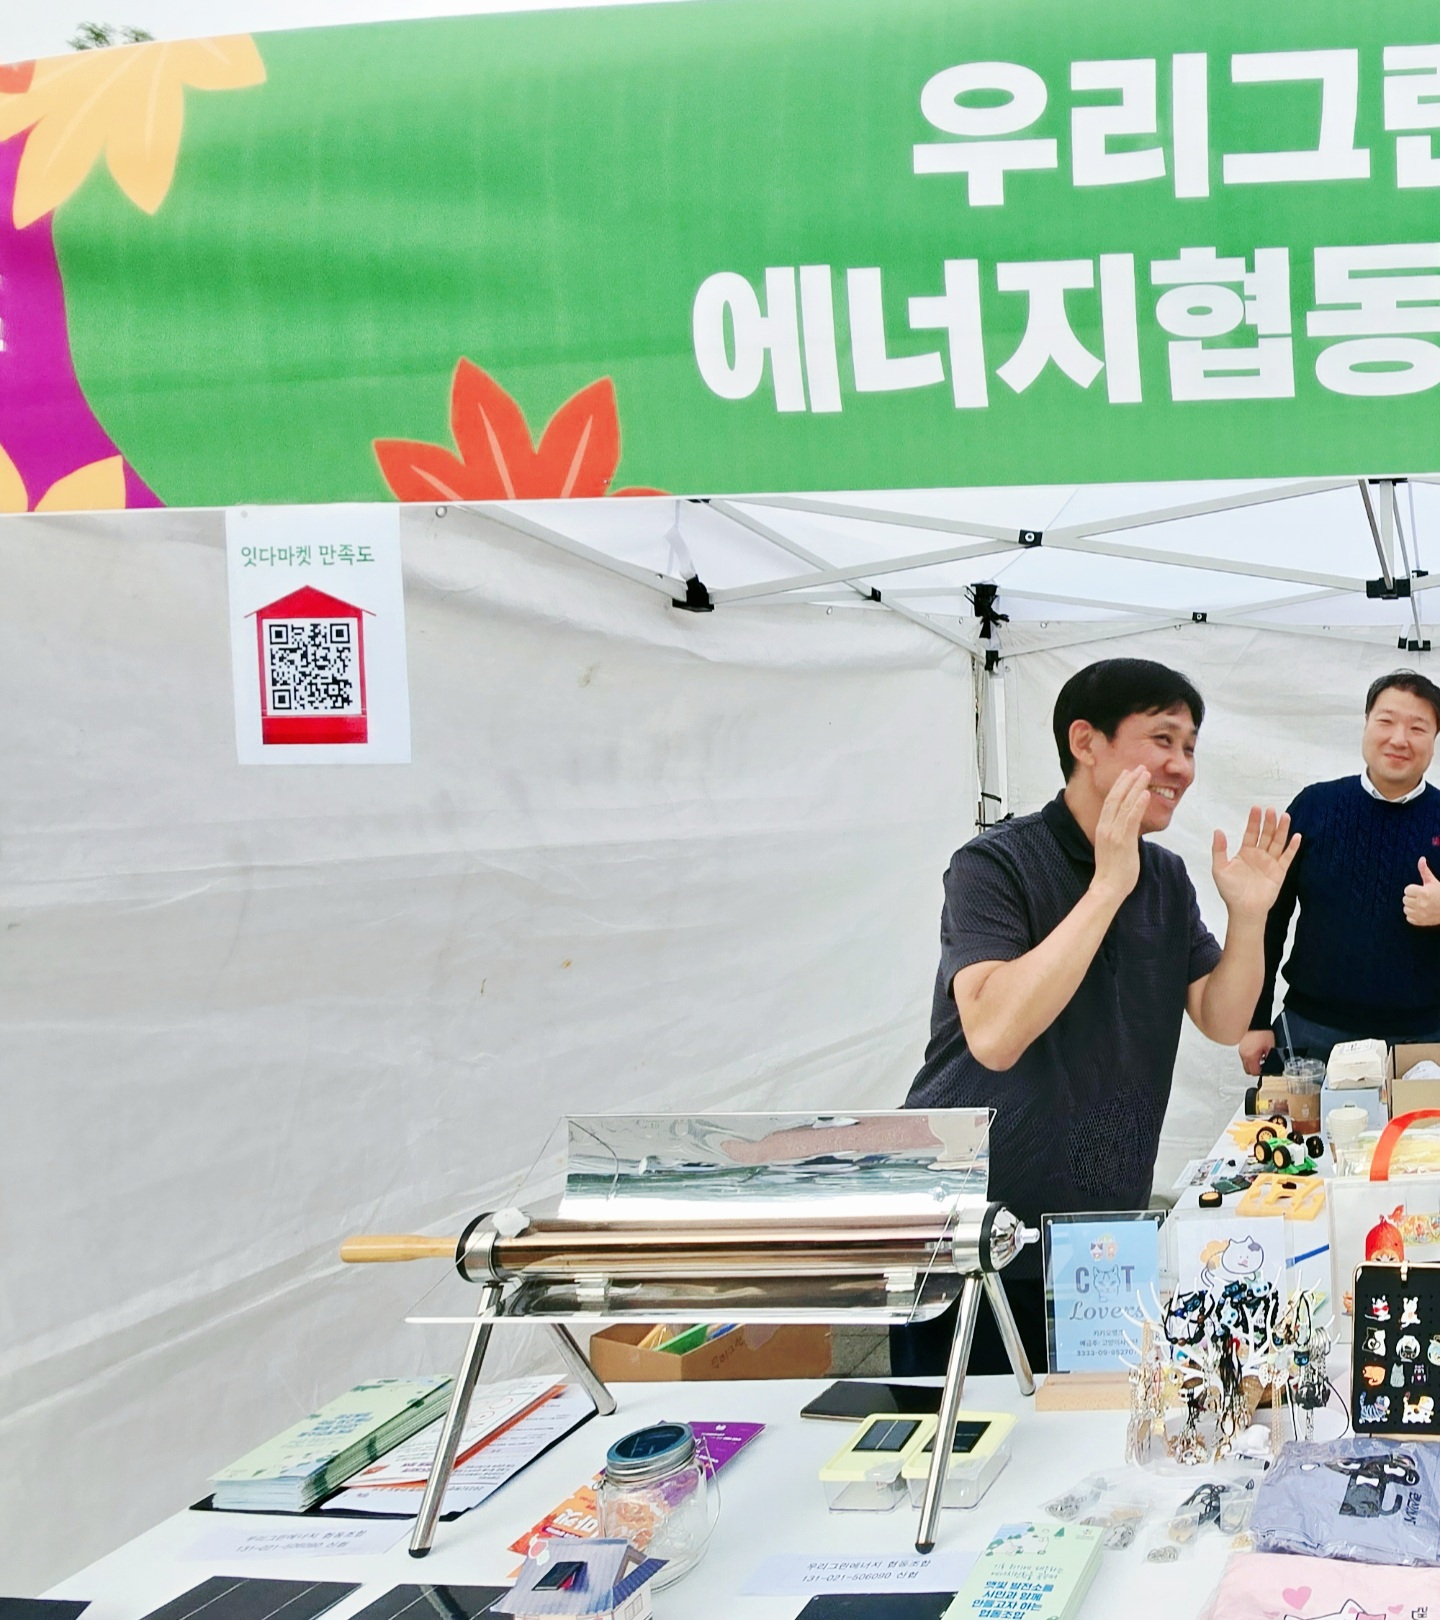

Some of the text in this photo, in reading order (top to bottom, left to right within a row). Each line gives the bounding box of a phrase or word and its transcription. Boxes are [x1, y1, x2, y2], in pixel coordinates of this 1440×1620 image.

[240, 544, 376, 567] 잇다마켓 만족도
[1069, 1300, 1145, 1321] Lovers
[807, 1559, 932, 1571] 우리그린에너지 협동조합
[982, 1590, 1018, 1600] 시민과
